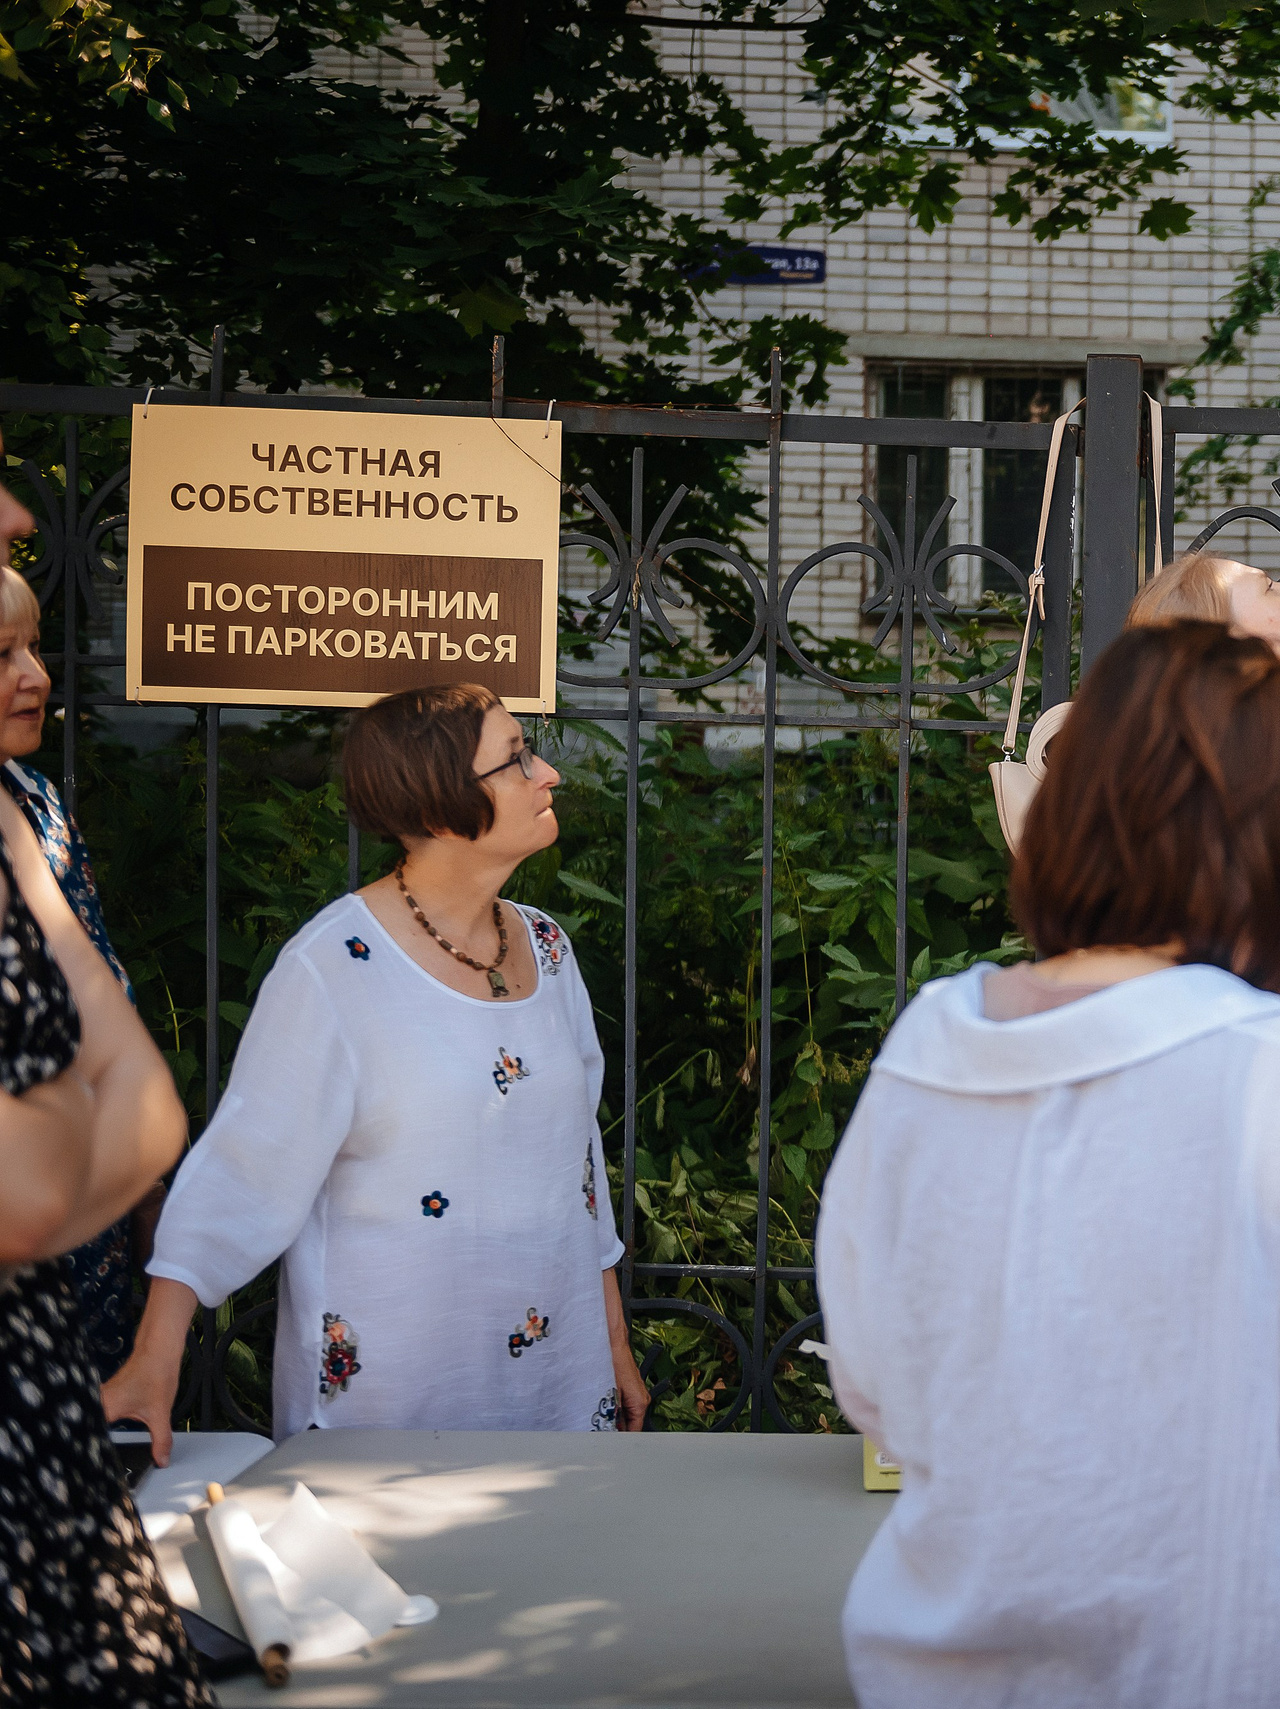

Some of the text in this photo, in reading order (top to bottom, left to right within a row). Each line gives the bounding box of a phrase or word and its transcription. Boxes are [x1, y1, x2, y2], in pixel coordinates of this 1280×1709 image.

[251, 442, 441, 478] ЧАСТНАЯ
[170, 482, 519, 523] СОБСТВЕННОСТЬ
[187, 581, 499, 620] ПОСТОРОННИМ
[166, 623, 518, 663] НЕ ПАРКОВАТЬСЯ
